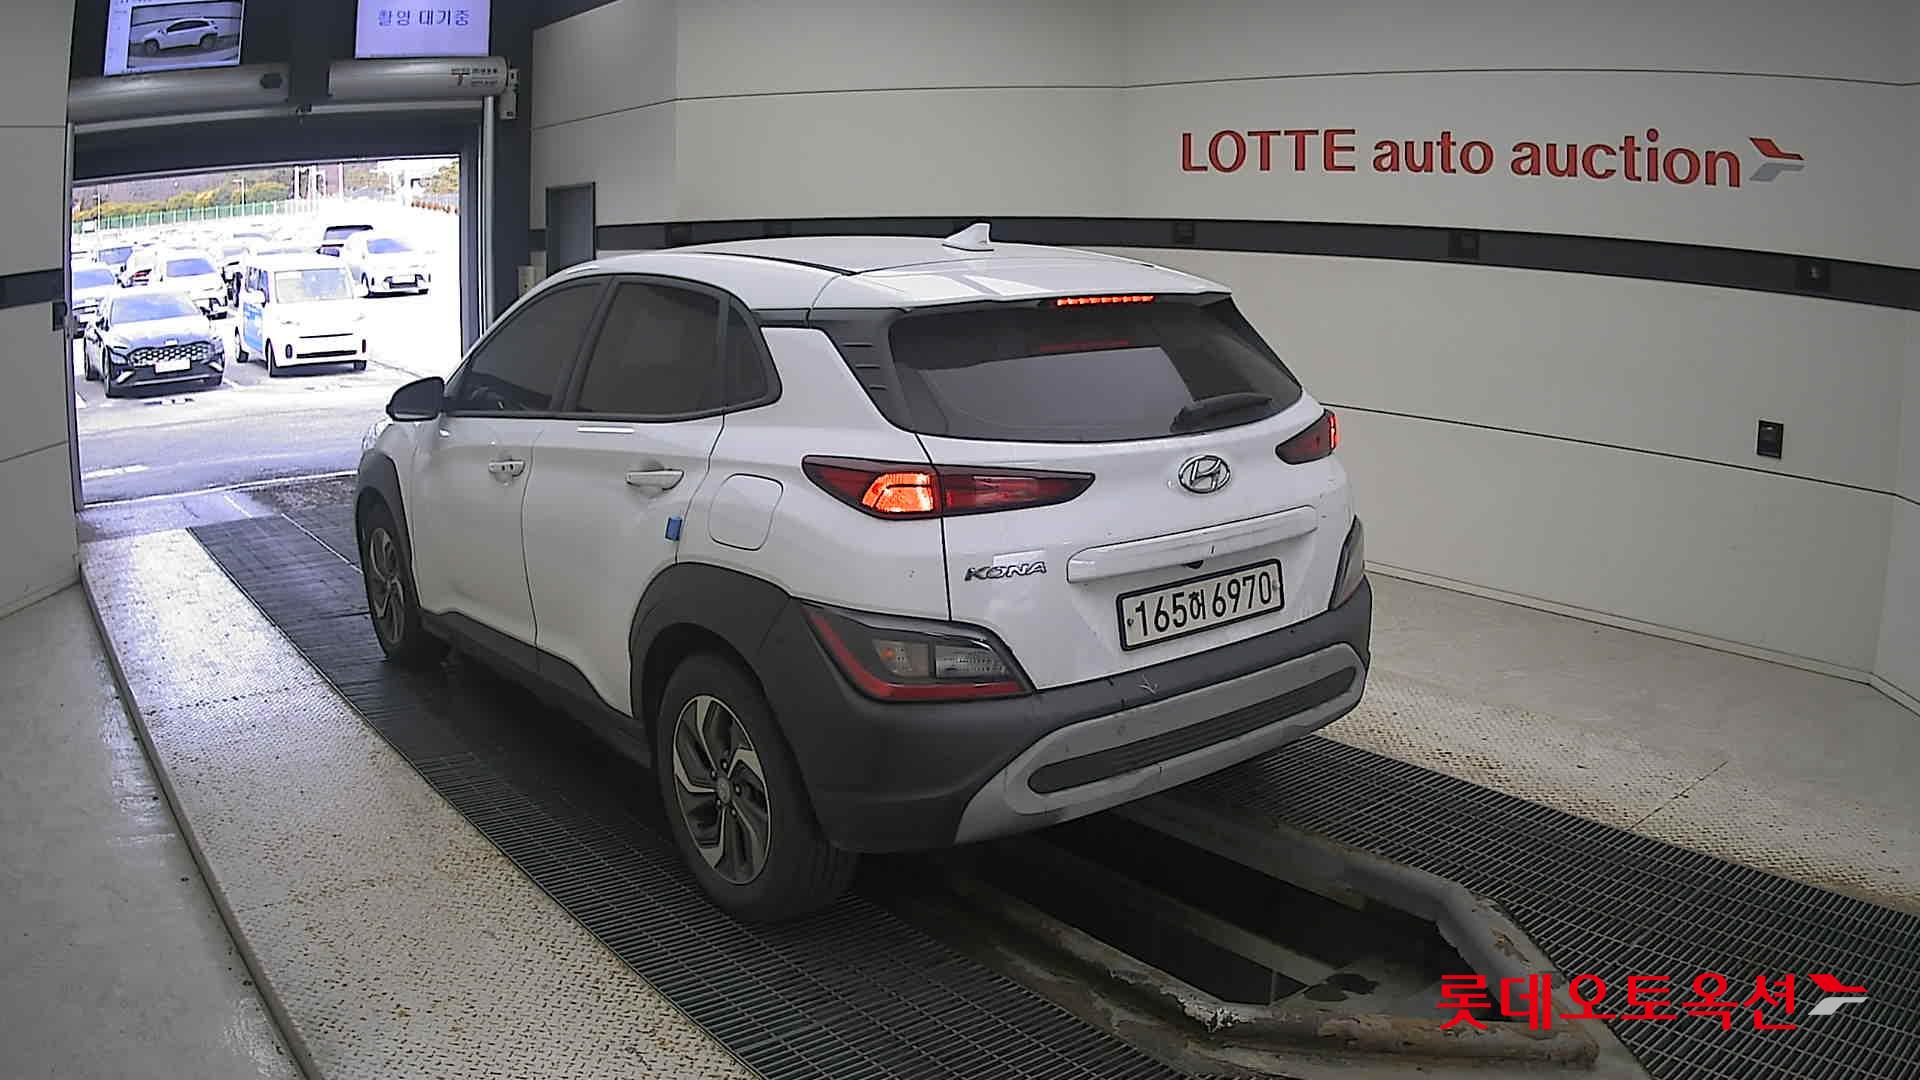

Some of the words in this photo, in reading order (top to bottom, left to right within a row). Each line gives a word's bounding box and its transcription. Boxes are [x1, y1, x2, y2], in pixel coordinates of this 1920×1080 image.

[1182, 128, 1357, 173] LOTTE
[1372, 131, 1494, 175] auto
[1511, 129, 1741, 188] auction
[964, 561, 1047, 581] KONA
